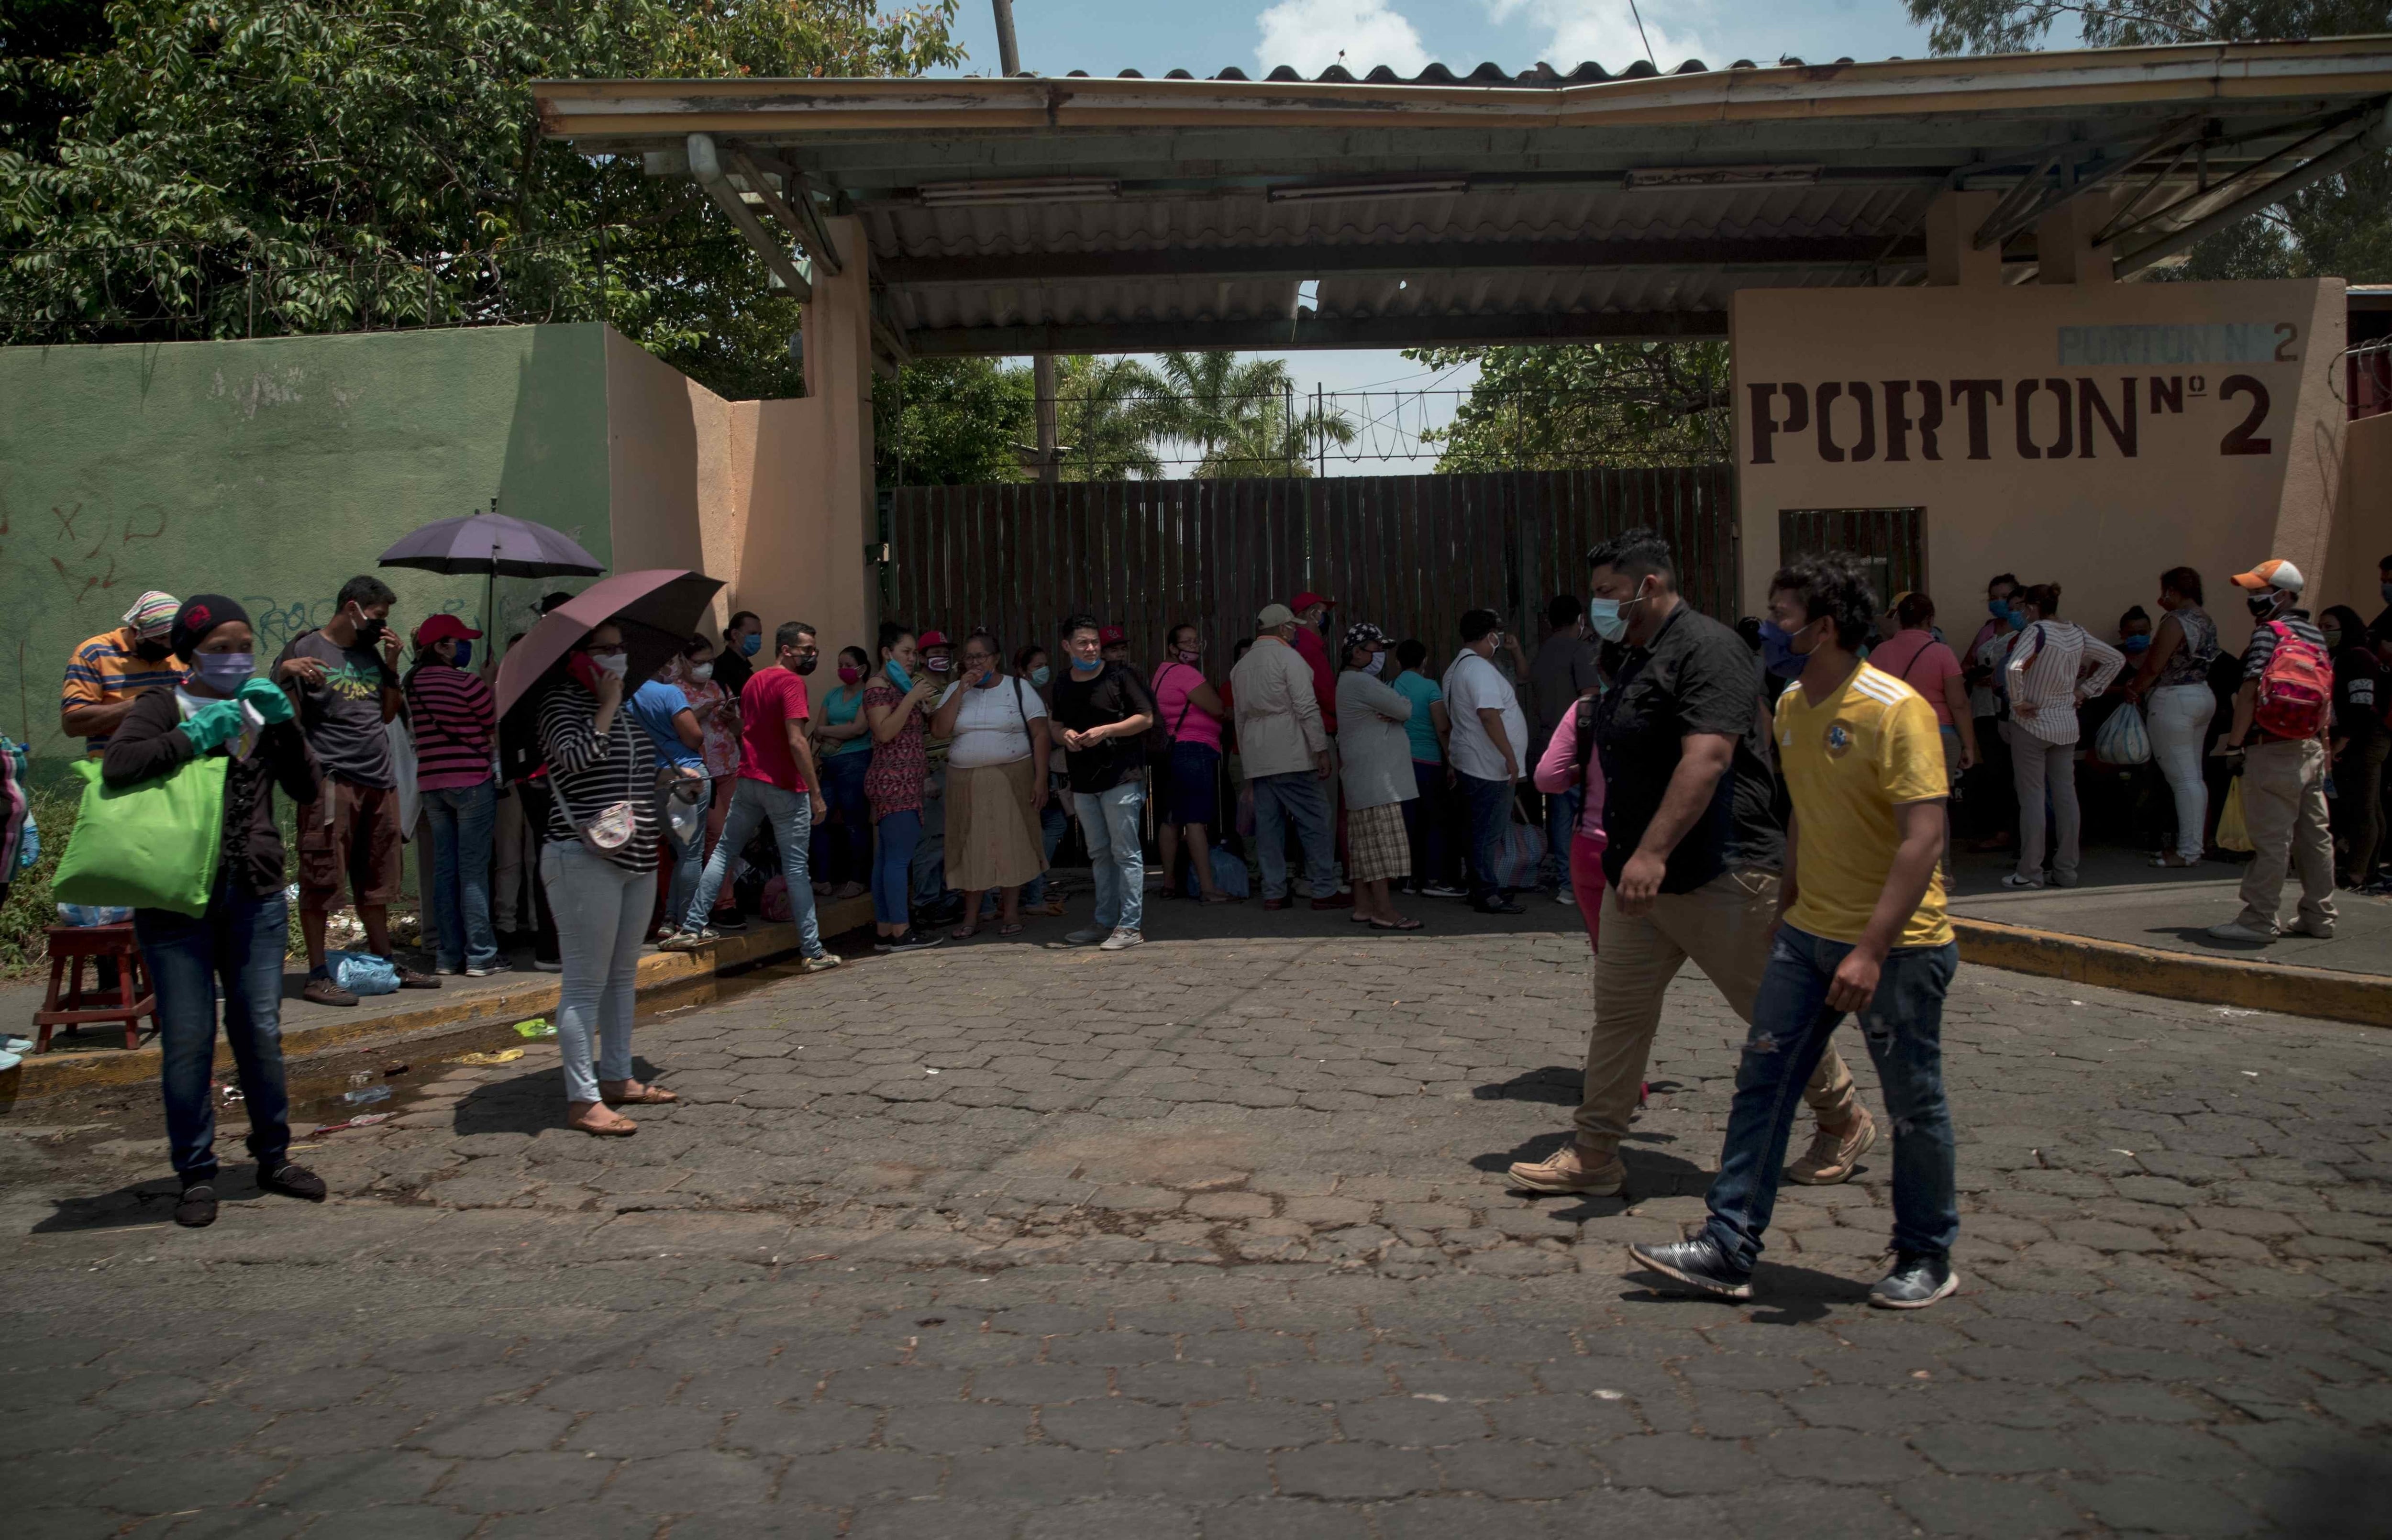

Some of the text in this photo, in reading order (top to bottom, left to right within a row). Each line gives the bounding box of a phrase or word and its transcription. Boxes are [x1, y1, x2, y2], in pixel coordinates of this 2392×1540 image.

[2274, 322, 2298, 362] 2
[1746, 377, 2138, 464] PORTON
[2219, 374, 2271, 456] 2
